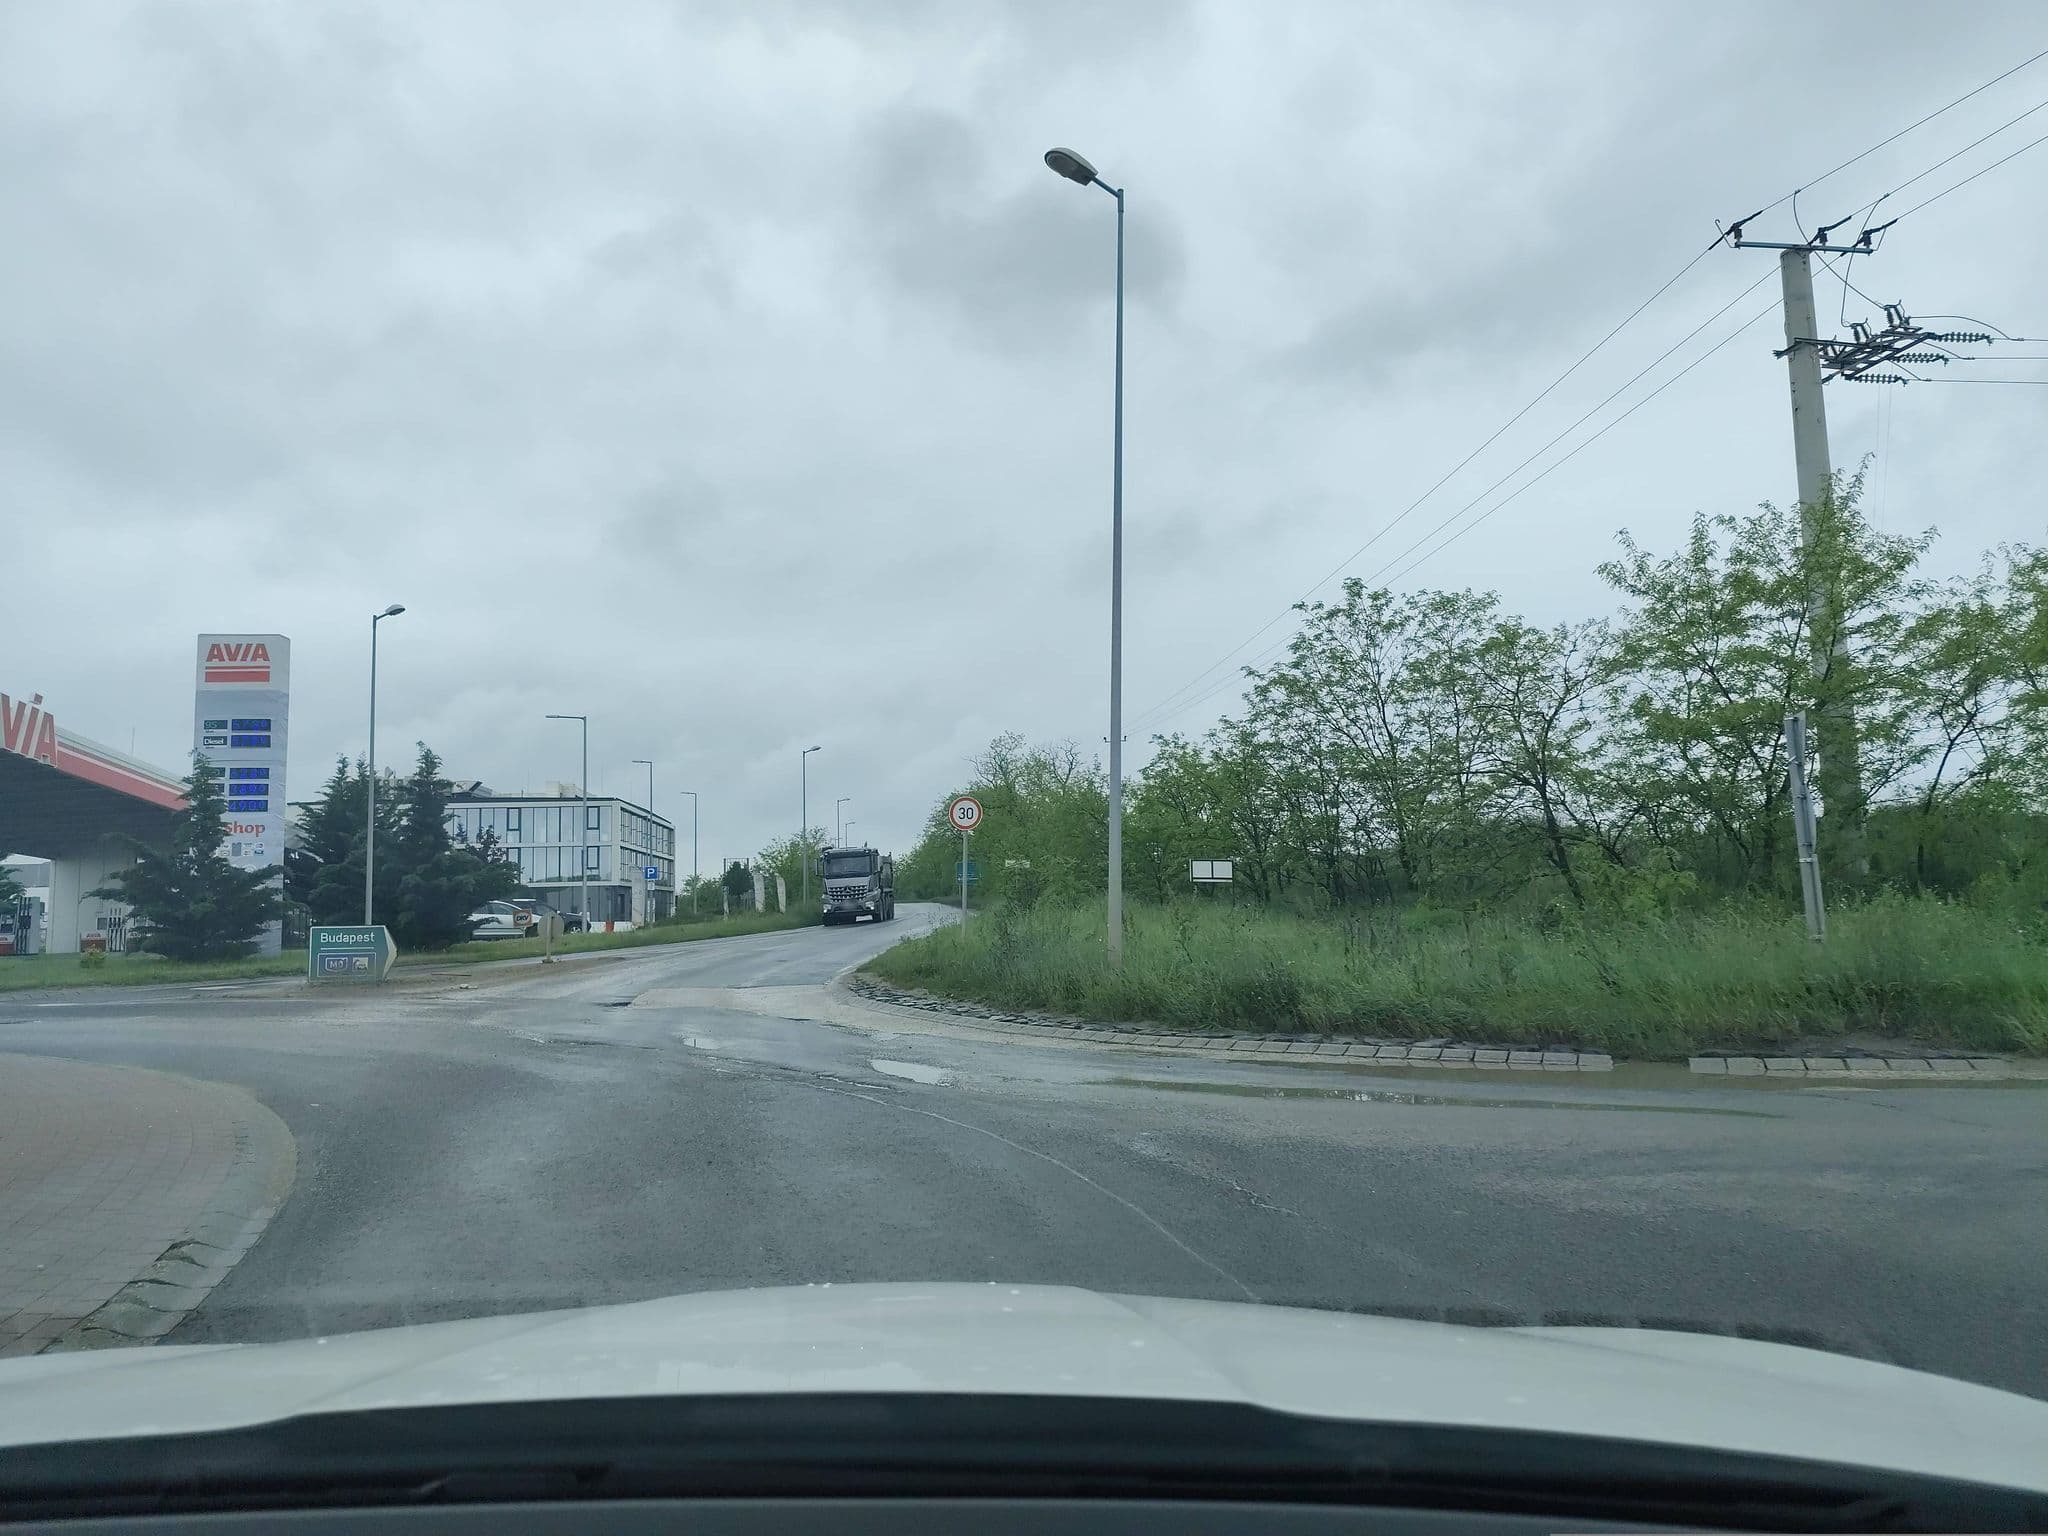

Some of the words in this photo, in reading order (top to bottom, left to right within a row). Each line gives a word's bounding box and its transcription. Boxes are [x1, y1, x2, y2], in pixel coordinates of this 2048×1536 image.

[207, 643, 271, 662] AVIA
[204, 737, 225, 745] Diesel
[958, 807, 974, 820] 30
[647, 868, 655, 878] P
[516, 914, 529, 922] DKV
[320, 932, 375, 944] Budapest
